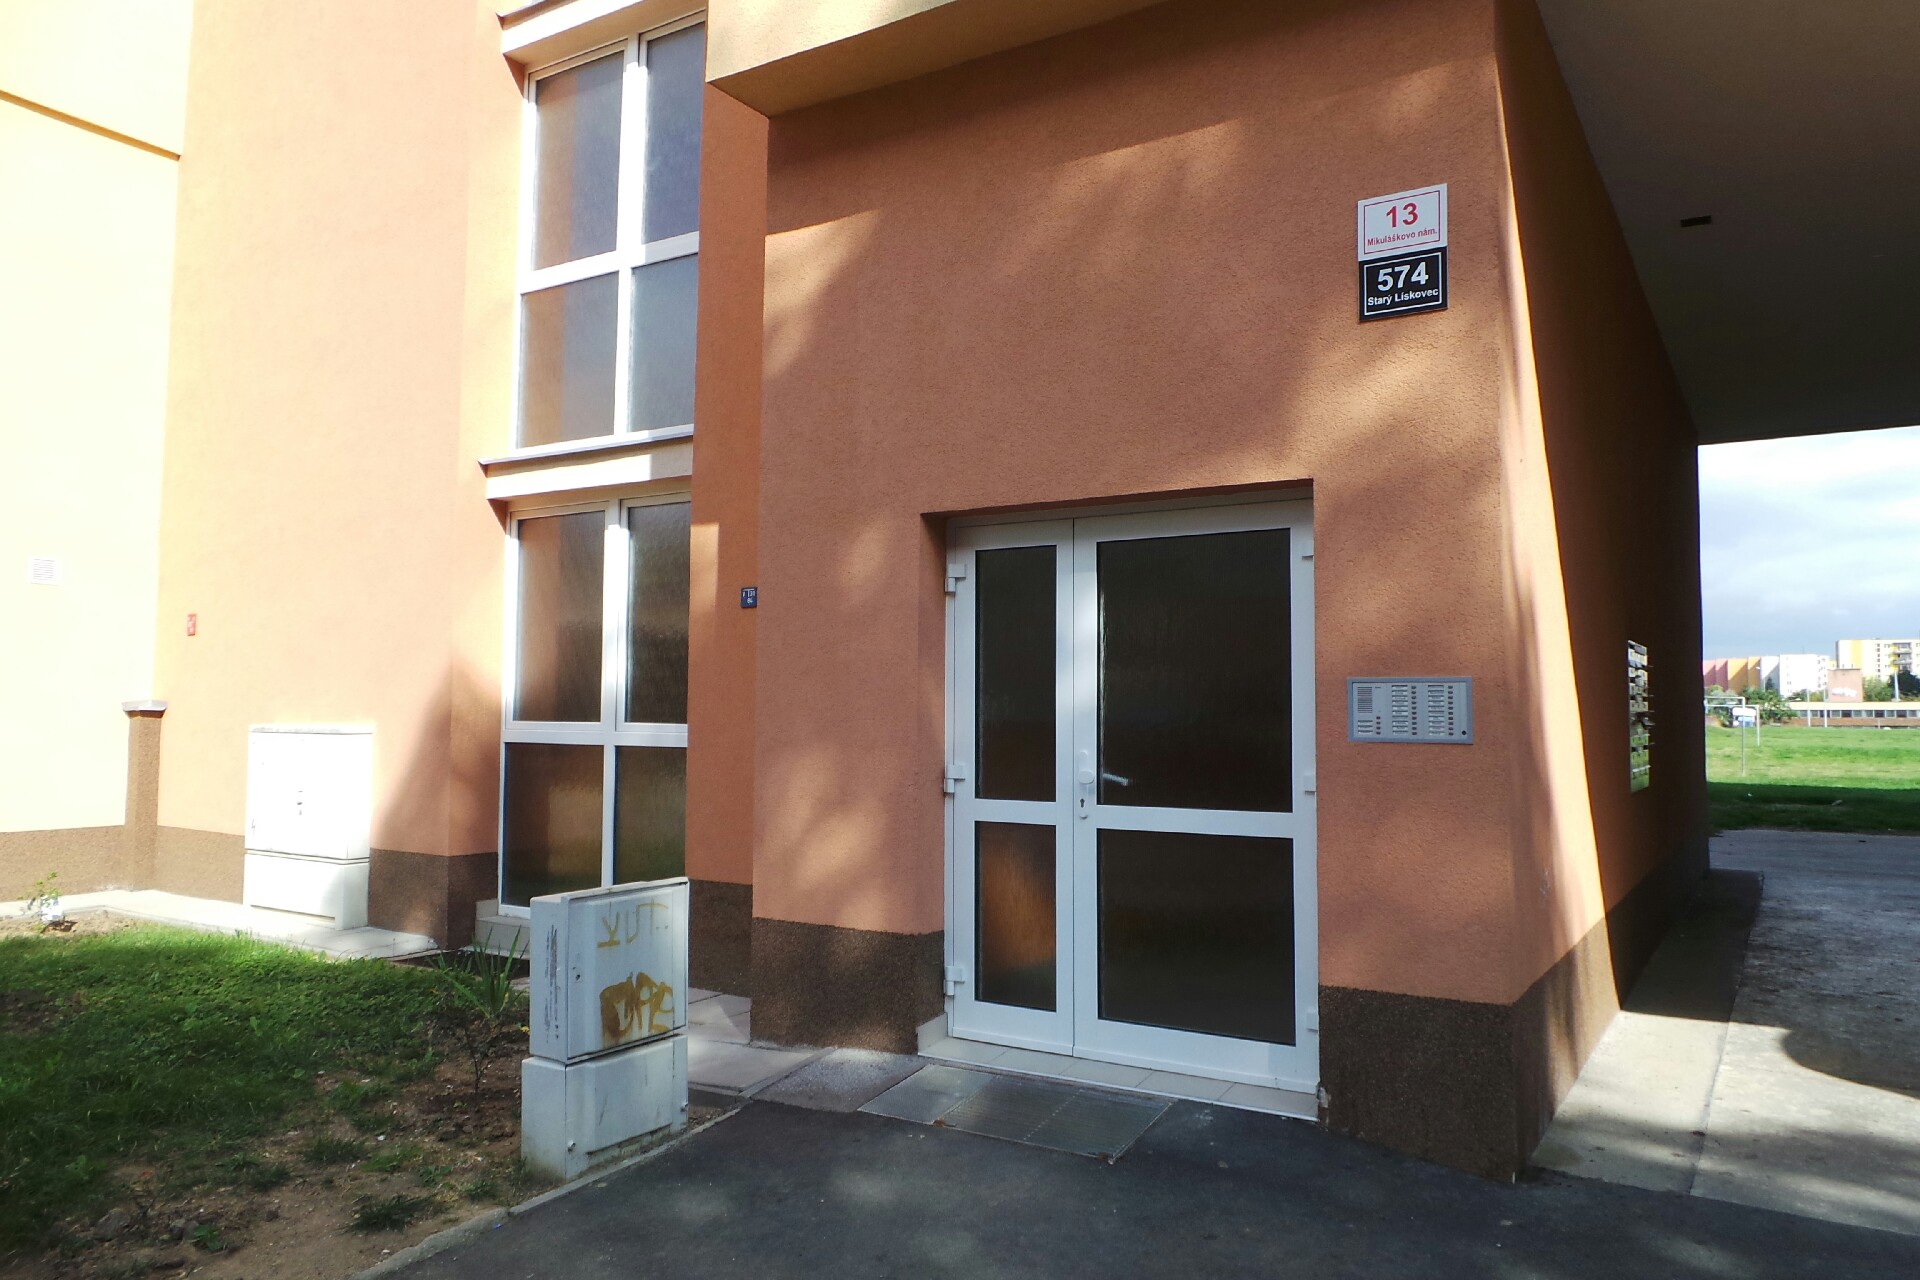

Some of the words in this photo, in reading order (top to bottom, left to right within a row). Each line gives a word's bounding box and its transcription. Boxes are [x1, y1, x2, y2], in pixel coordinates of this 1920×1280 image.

[1386, 202, 1419, 228] 13
[1367, 231, 1416, 246] Mikuláškovo
[1417, 227, 1438, 238] nám.
[1377, 261, 1429, 292] 574
[1367, 295, 1392, 306] Starý
